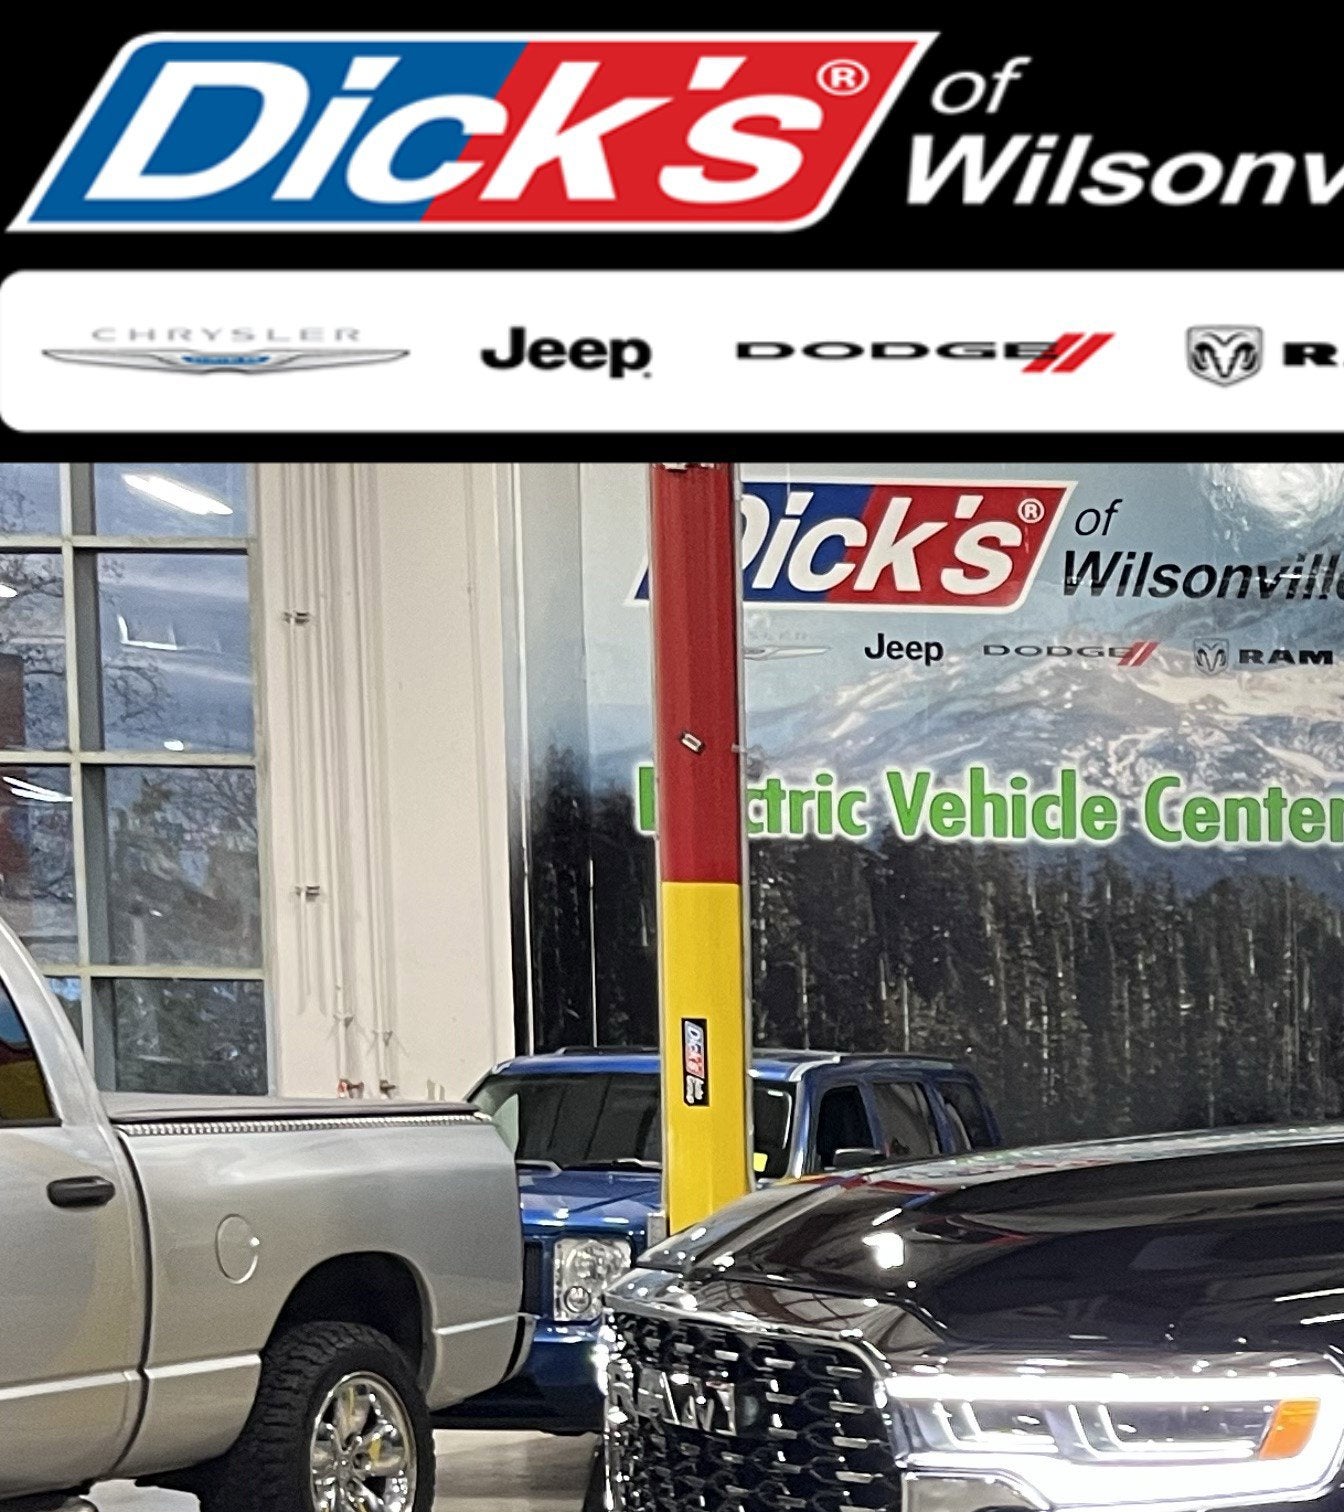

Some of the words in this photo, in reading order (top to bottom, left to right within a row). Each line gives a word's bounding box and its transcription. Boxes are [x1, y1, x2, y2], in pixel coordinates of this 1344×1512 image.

[1074, 498, 1124, 537] of
[743, 491, 1022, 597] ick's
[864, 633, 944, 667] Jeep
[982, 643, 1128, 660] DODGE
[1238, 648, 1334, 666] RAM
[638, 767, 867, 838] ctric
[886, 769, 1117, 841] Vehicle
